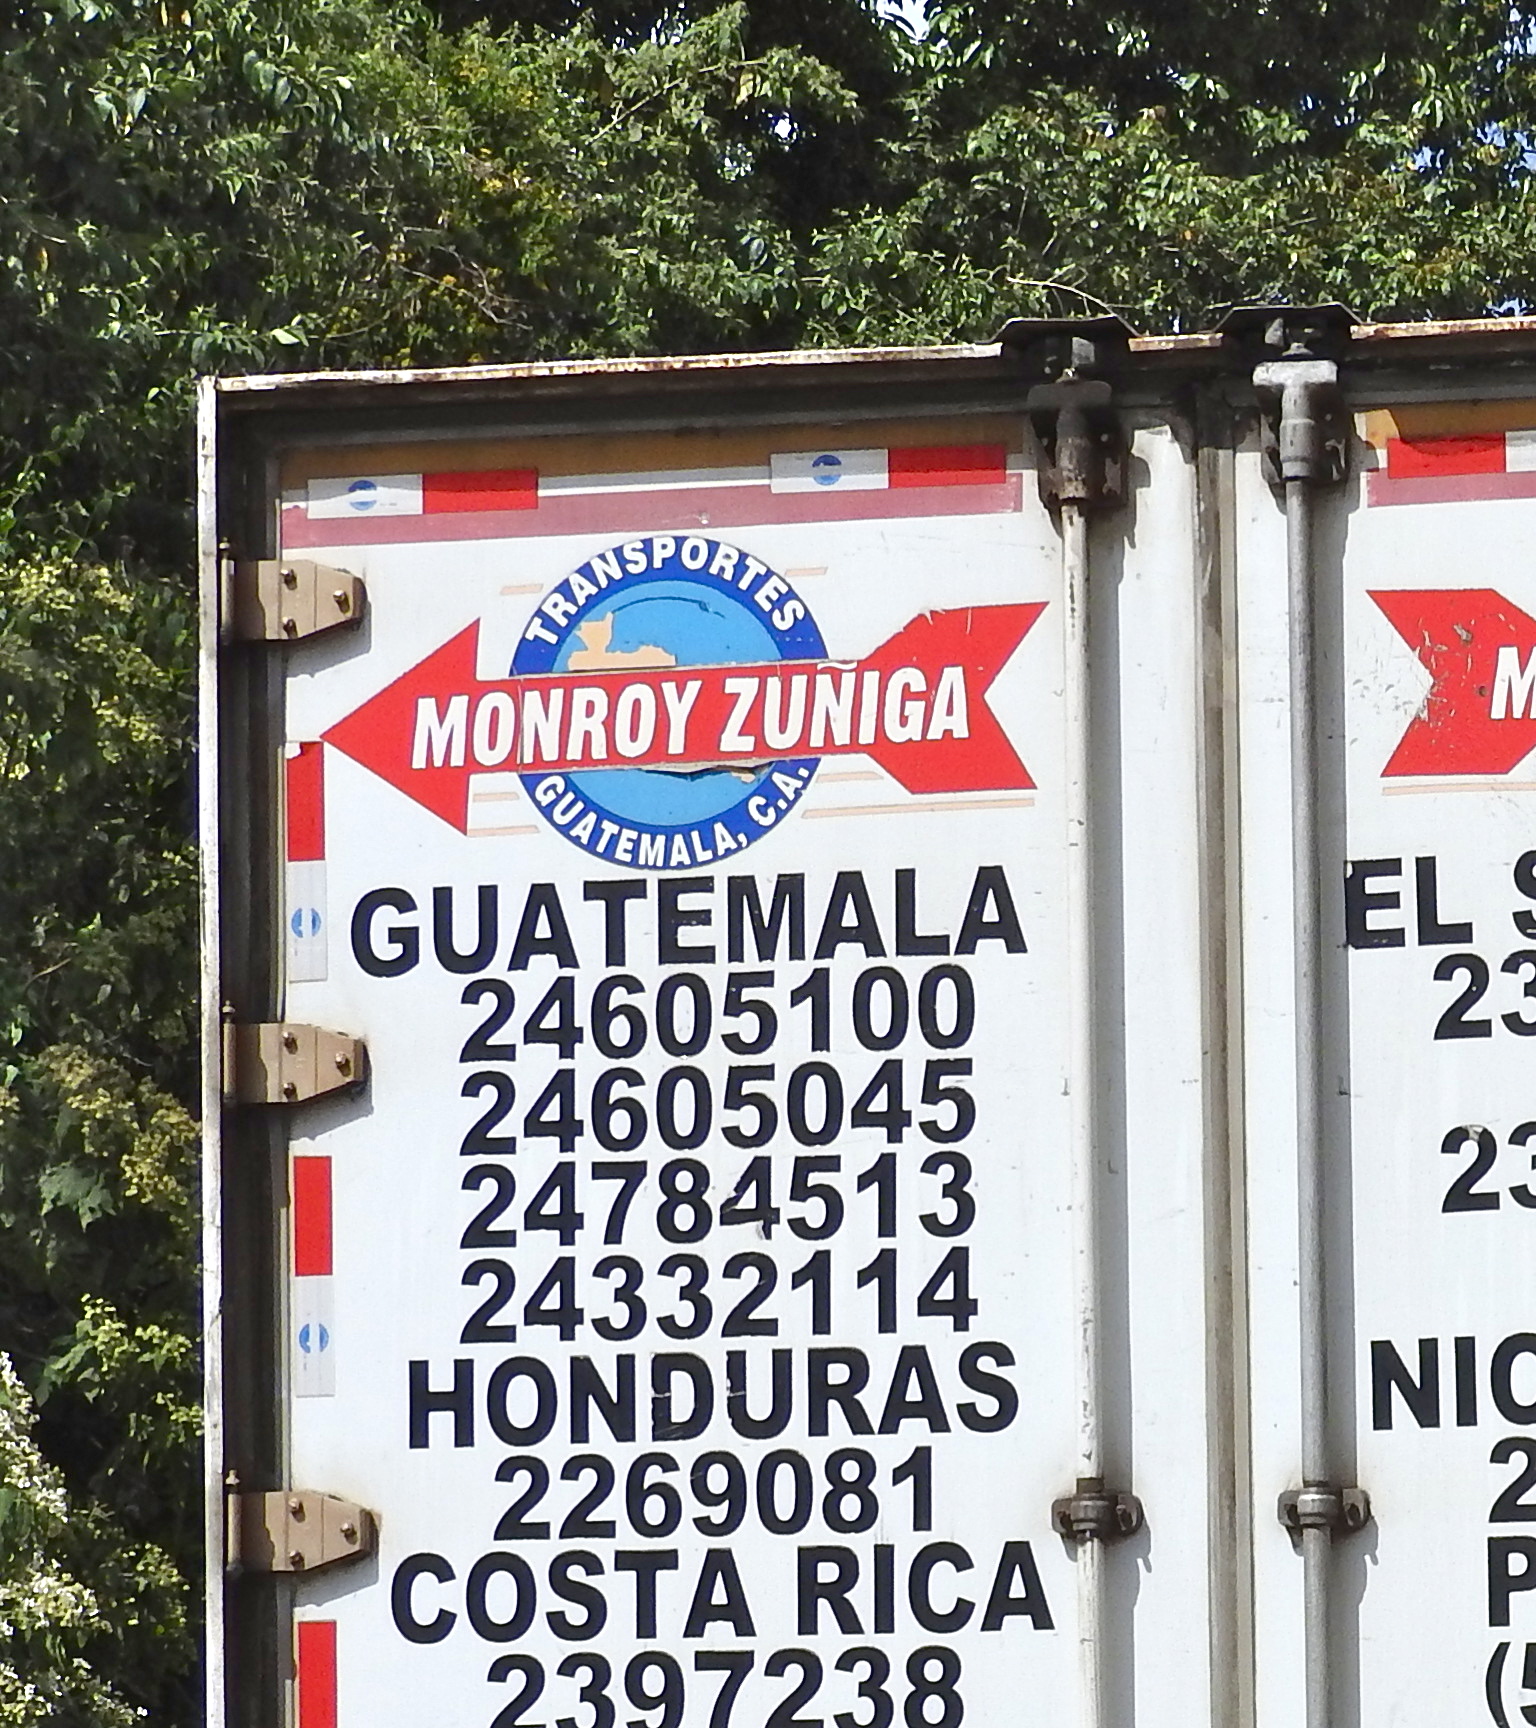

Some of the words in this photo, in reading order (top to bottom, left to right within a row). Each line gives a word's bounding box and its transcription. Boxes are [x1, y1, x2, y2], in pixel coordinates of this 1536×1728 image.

[526, 537, 806, 649] TRANSPORTES
[411, 681, 702, 771] MONROY
[720, 662, 970, 753] ZUÑIGA
[536, 776, 748, 868] GUATEMALA,
[751, 765, 811, 827] C.A.
[351, 866, 1027, 977] GUATEMALA
[1342, 856, 1472, 949] EL
[460, 964, 974, 1062] 24605100
[460, 1058, 975, 1155] 24605045
[461, 1151, 975, 1248] 24784513
[461, 1247, 977, 1343] 24332114
[409, 1342, 1018, 1448] HONDURAS
[494, 1446, 931, 1540] 2269081
[392, 1549, 756, 1644] COSTA
[798, 1541, 1054, 1635] RICA
